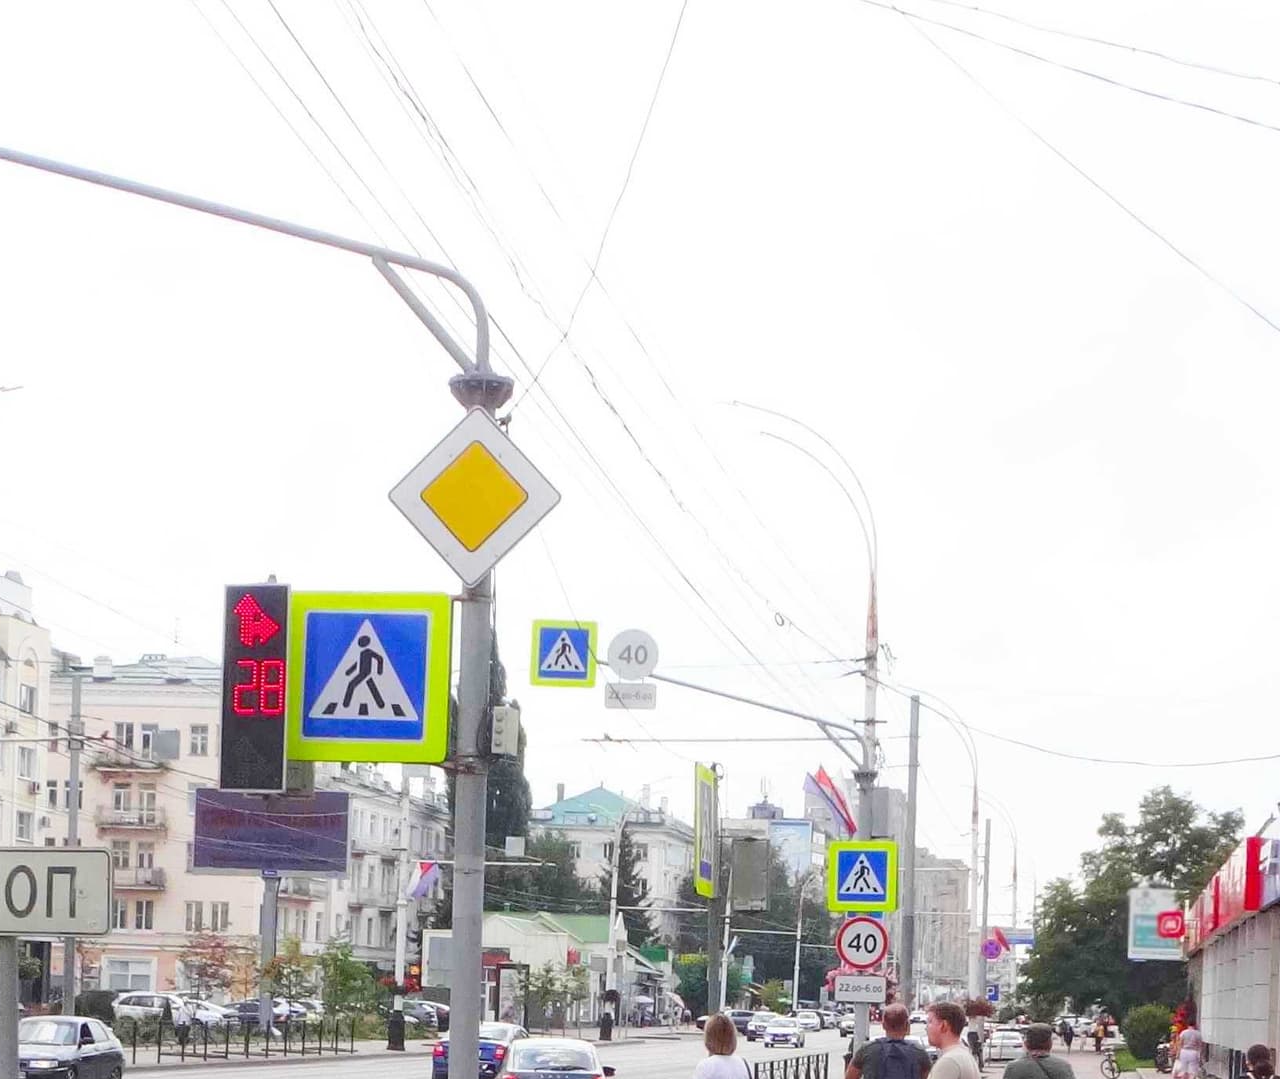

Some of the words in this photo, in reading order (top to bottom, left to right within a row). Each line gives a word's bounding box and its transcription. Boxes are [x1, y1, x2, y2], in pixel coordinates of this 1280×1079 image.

[618, 644, 648, 664] 40
[233, 658, 286, 715] 28
[847, 932, 878, 954] 40
[838, 982, 883, 993] 22.00-6.00
